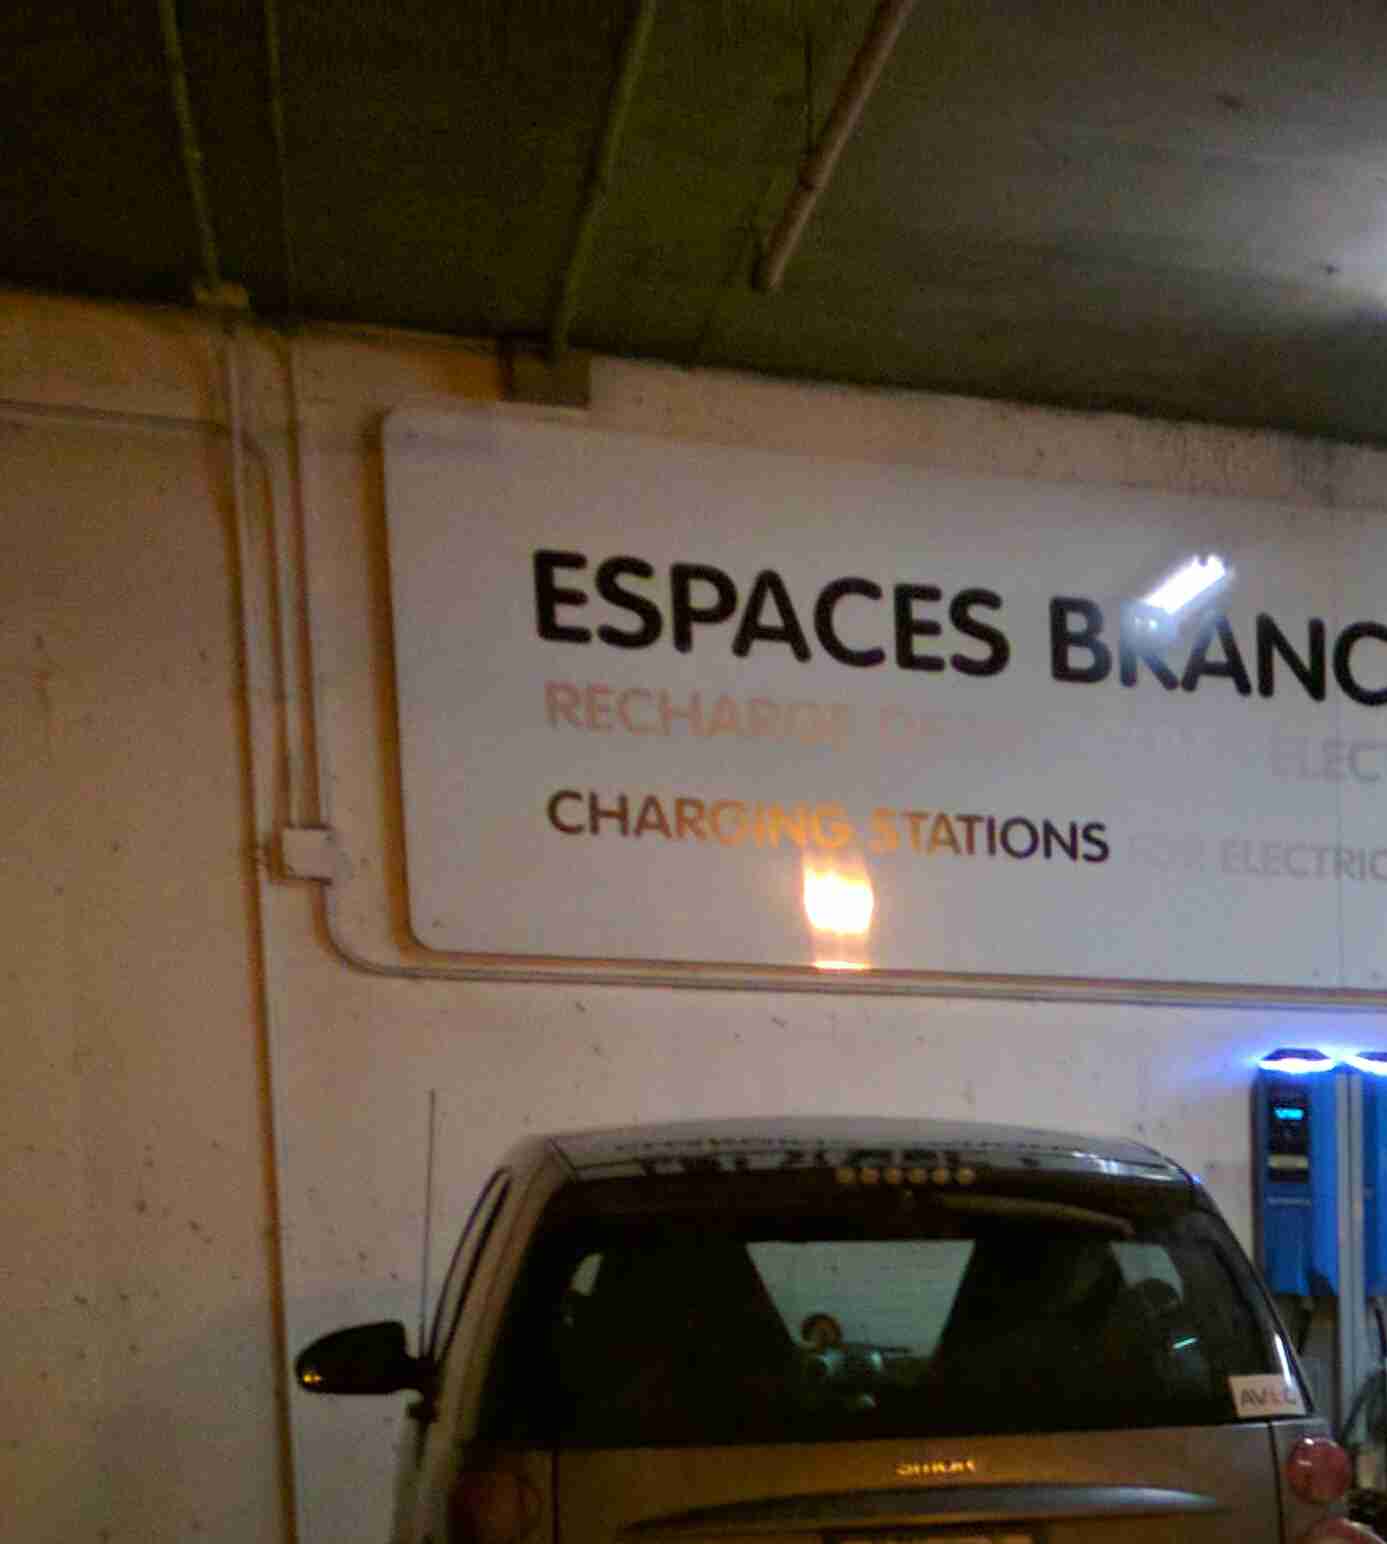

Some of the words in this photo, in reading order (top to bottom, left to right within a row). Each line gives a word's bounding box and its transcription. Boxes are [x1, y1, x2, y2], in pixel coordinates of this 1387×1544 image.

[533, 548, 1011, 676] ESPACES
[545, 789, 853, 850] CHARGING
[867, 805, 1111, 864] STATIONS
